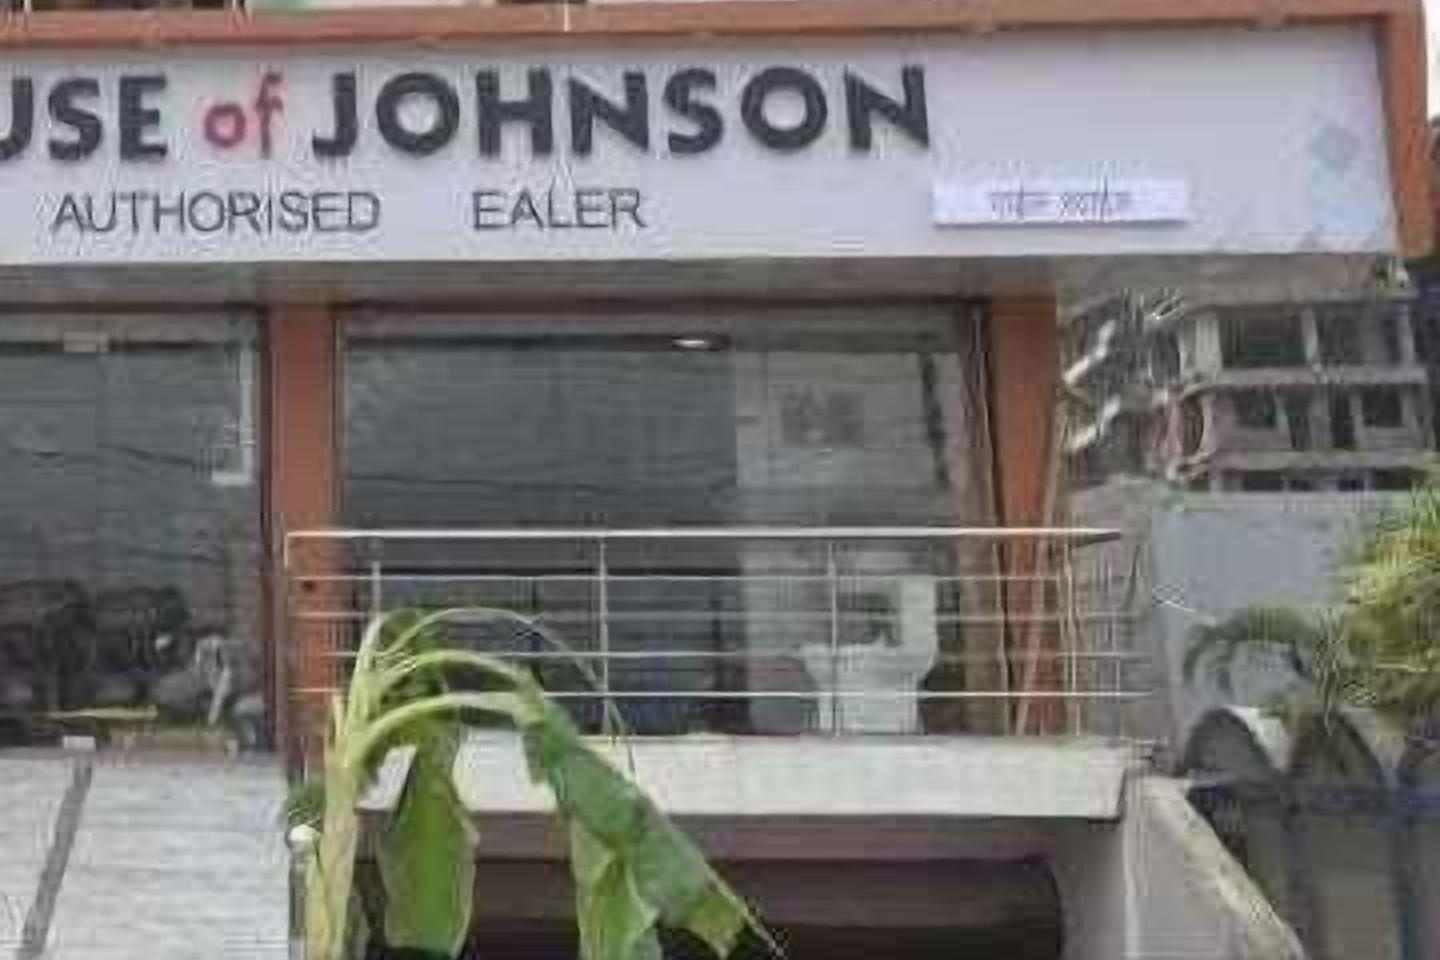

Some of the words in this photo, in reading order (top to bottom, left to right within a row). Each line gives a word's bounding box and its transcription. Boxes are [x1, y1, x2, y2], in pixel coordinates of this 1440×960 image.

[202, 72, 284, 158] of
[312, 65, 929, 156] JOHNSON
[53, 191, 381, 233] AUTHORISED
